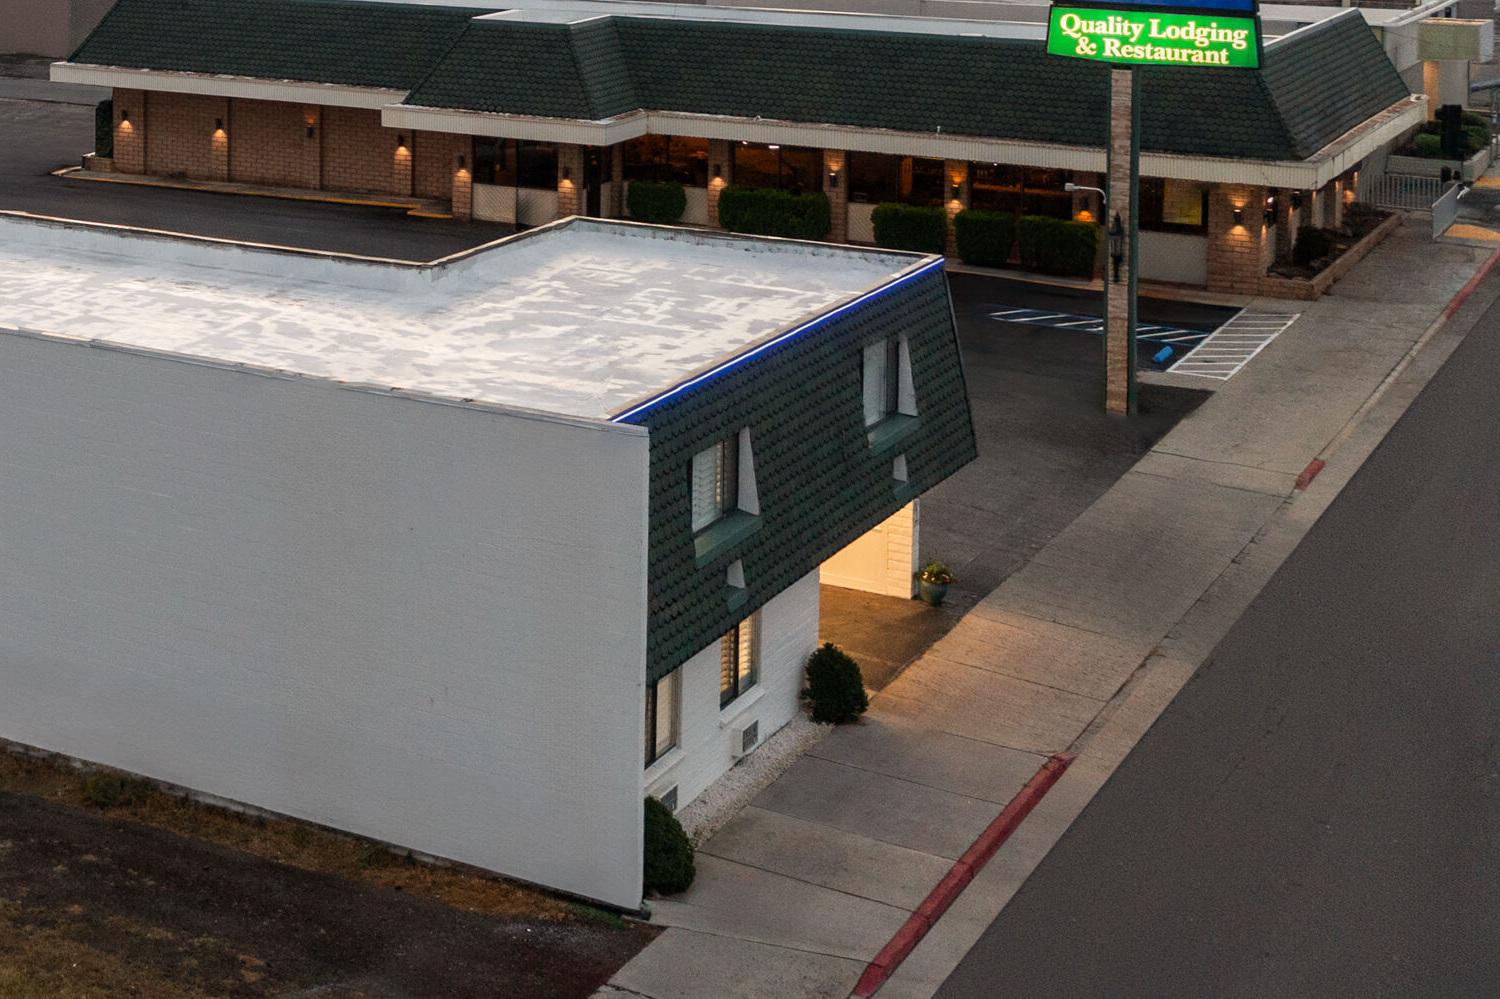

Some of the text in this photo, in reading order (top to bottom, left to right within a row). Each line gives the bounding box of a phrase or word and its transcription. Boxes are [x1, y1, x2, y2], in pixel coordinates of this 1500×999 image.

[1059, 13, 1249, 50] Quality Lodging
[1075, 36, 1229, 65] & Restaurant
